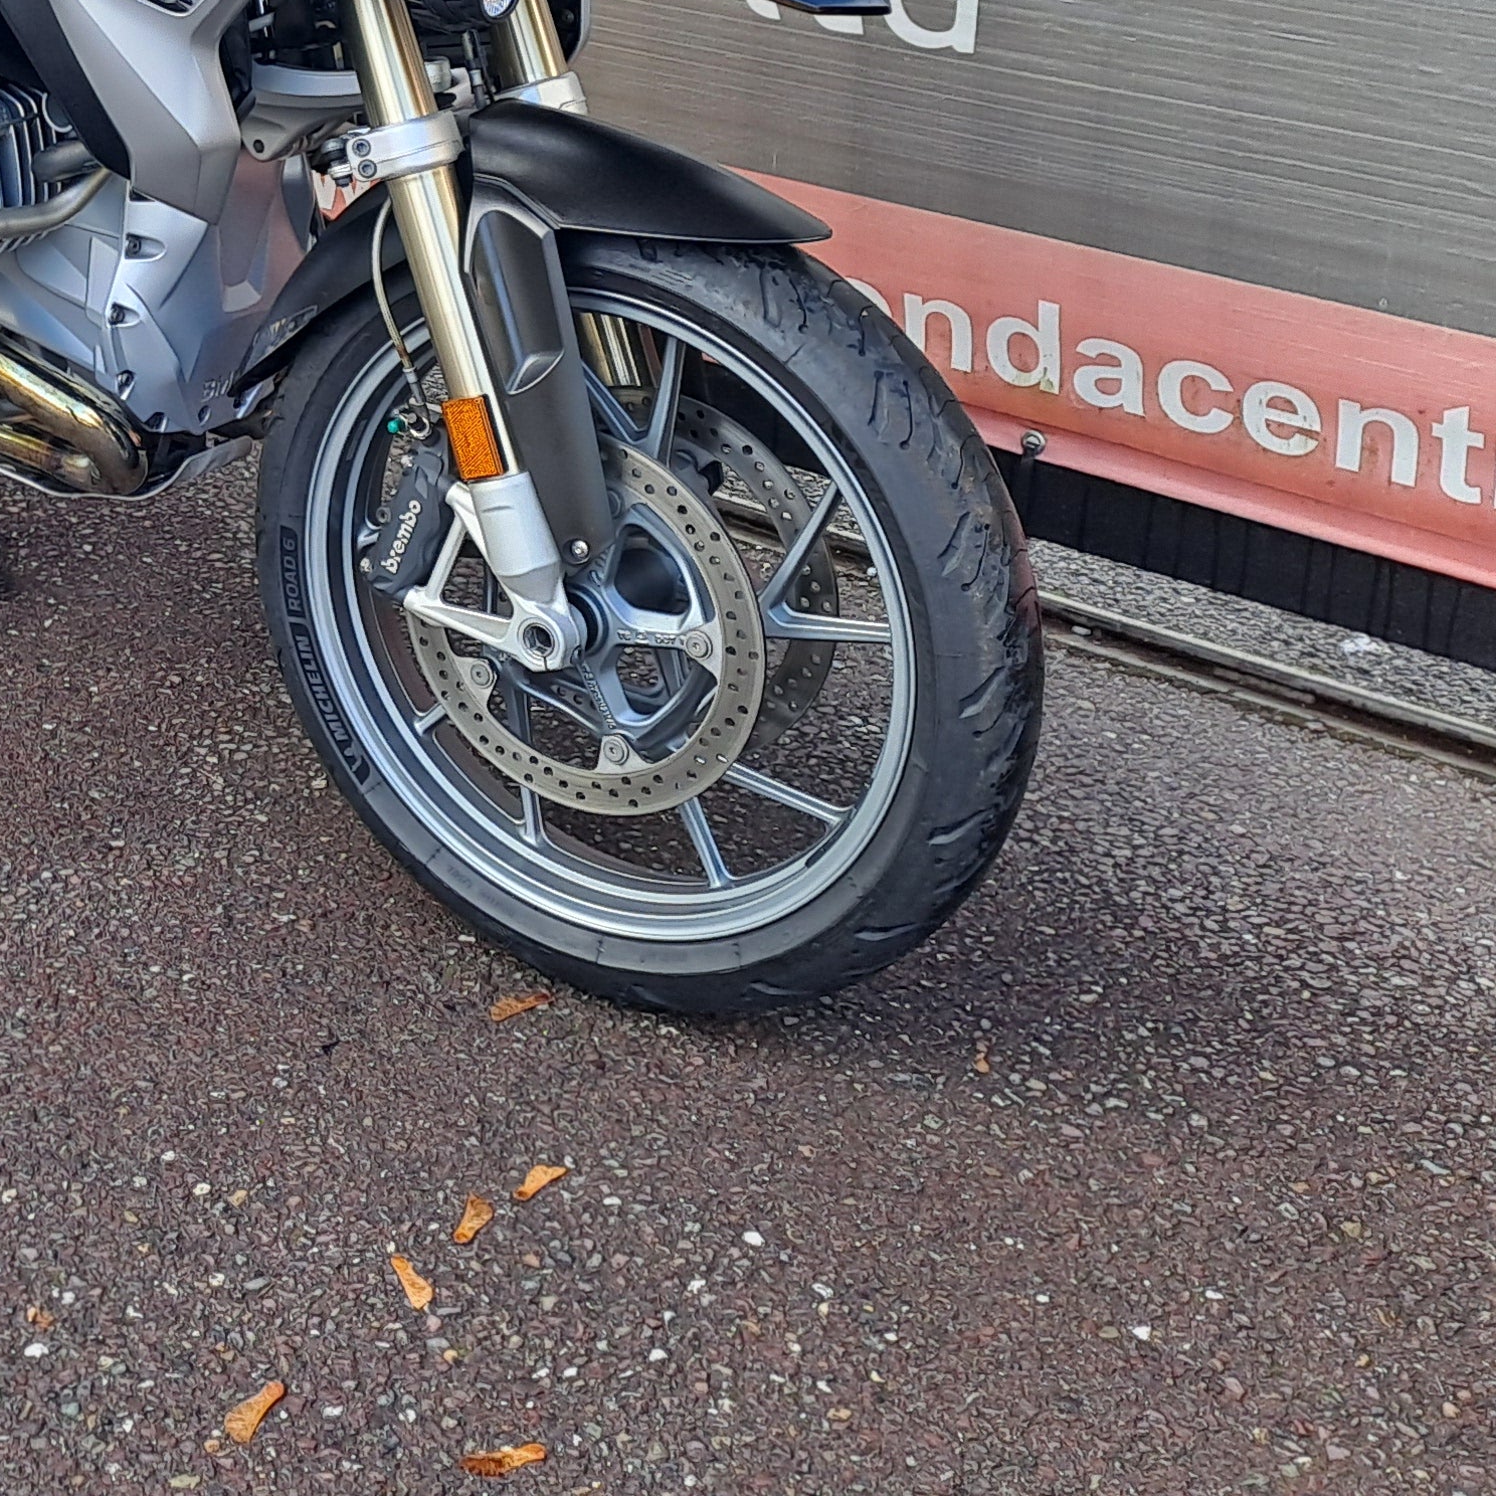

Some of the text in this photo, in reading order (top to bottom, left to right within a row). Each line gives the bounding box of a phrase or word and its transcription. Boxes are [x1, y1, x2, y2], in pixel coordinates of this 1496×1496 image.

[845, 276, 1496, 504] ndacent
[282, 536, 349, 743] MICHELIN ROAD 6
[381, 499, 422, 574] brembo
